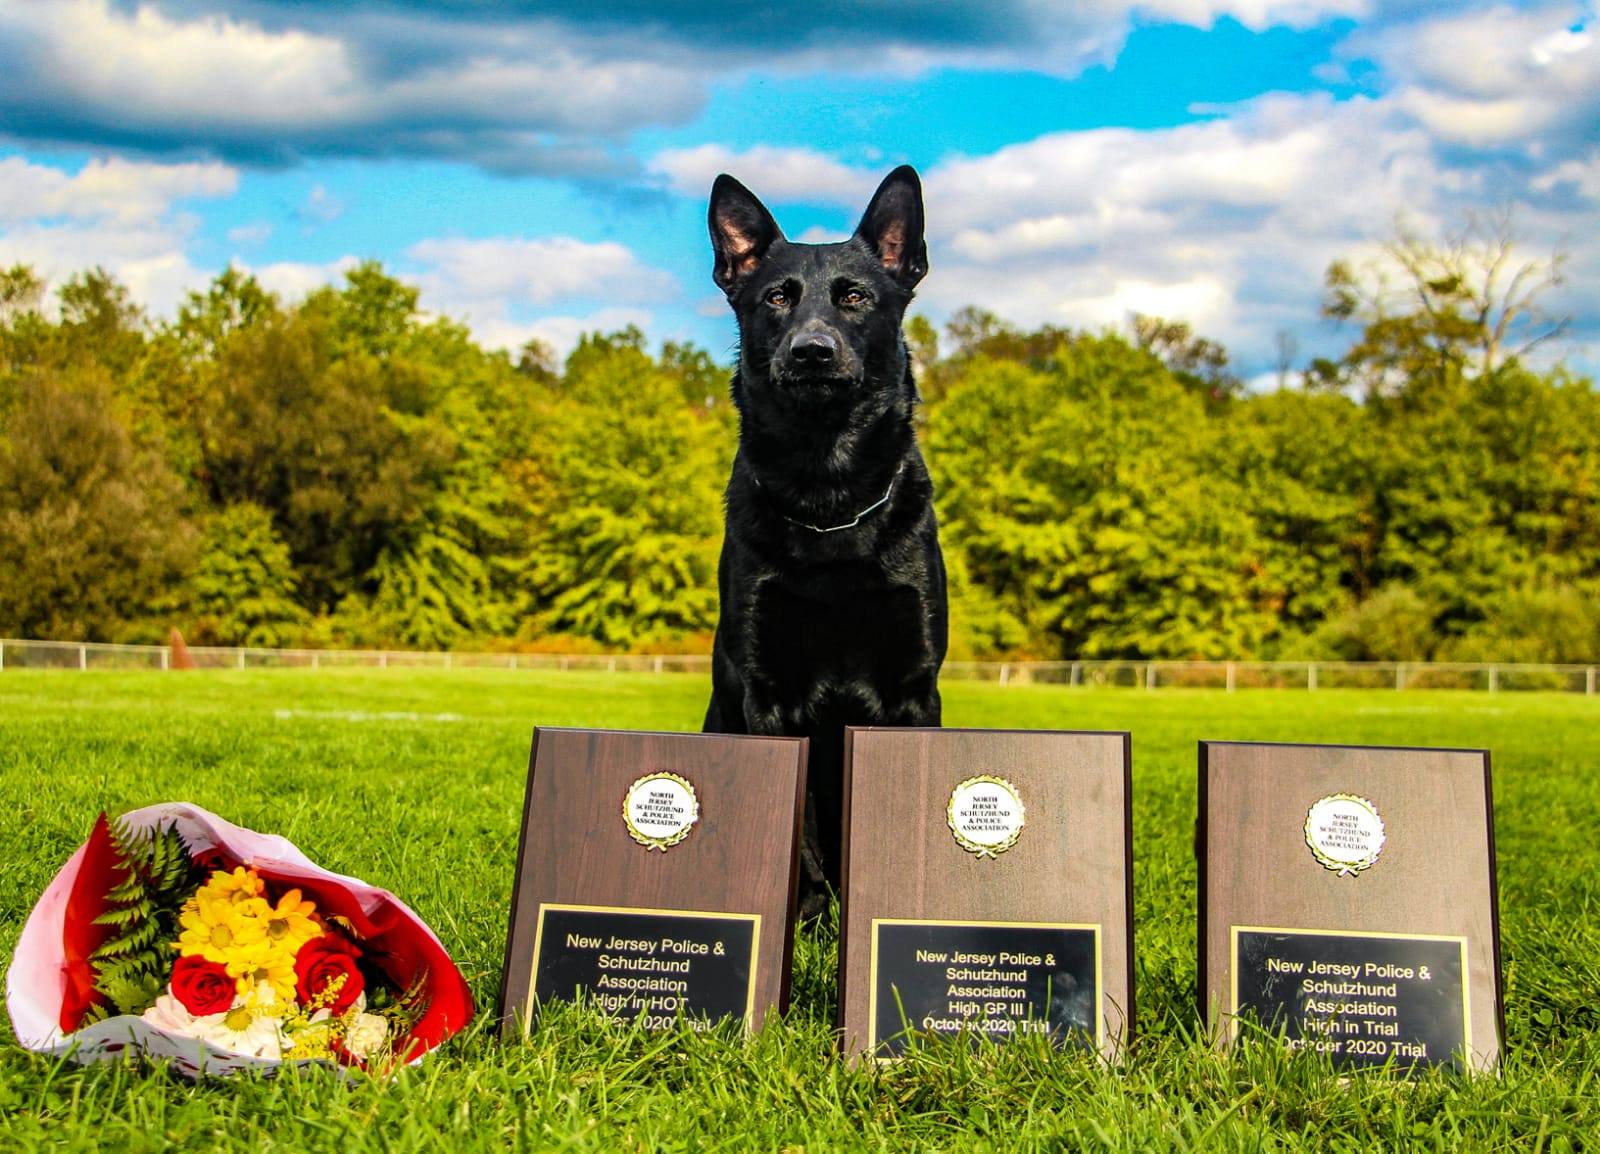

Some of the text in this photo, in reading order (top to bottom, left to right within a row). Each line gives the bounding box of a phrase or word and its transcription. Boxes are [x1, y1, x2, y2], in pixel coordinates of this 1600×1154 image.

[636, 804, 684, 813] SCHUTZHUND
[635, 818, 681, 826] ASSOCIATION
[1320, 827, 1370, 837] SCHUTZHUND
[1335, 835, 1360, 843] POLICE
[1321, 841, 1369, 850] ASSOCIATION
[566, 934, 725, 956] New Jersey Police &
[598, 955, 690, 972] Schutzhund
[916, 950, 1056, 967] New Jersey Police &
[946, 968, 1027, 982] Schutzhund
[1267, 958, 1431, 980] New Jersey Police &
[597, 974, 688, 992] Association
[1303, 979, 1397, 997] Schutzhund
[947, 984, 1026, 999] Association
[593, 992, 688, 1011] High in HOT
[949, 1001, 980, 1016] High
[985, 1002, 1007, 1014] GP
[1304, 1000, 1397, 1016] Association
[982, 1019, 1016, 1032] 2020
[1303, 1017, 1398, 1036] High in Trial
[1346, 1039, 1386, 1055] 2020
[1391, 1042, 1426, 1058] Trial
